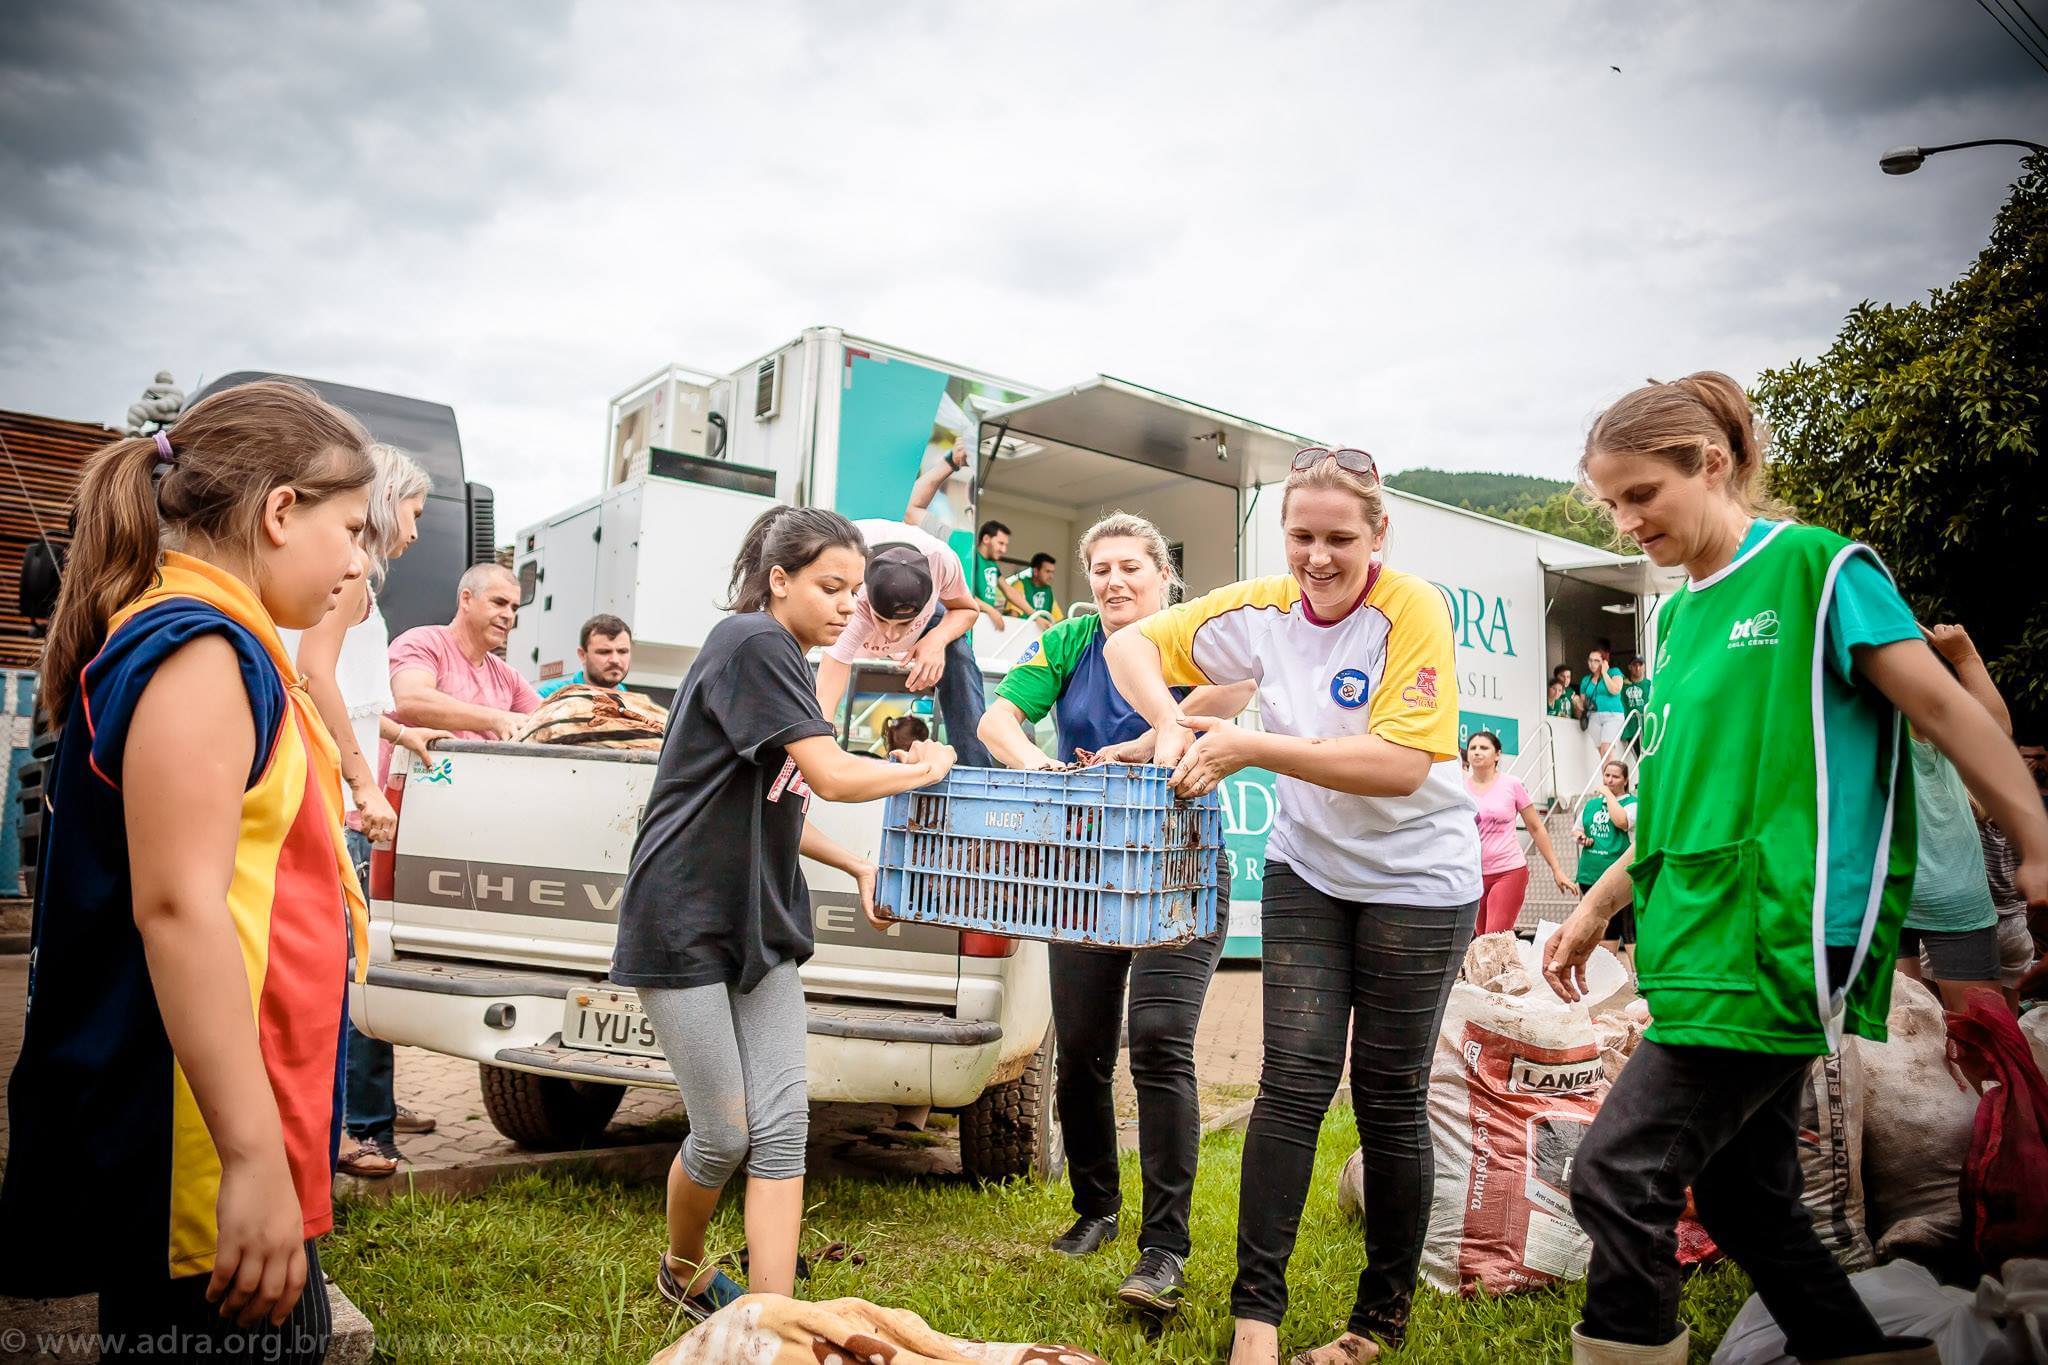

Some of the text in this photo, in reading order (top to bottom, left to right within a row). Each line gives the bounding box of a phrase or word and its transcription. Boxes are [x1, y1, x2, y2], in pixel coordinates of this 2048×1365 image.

[1747, 638, 1779, 646] CENTER
[984, 810, 1025, 830] INJECT
[1471, 1148, 1492, 1210] Postura
